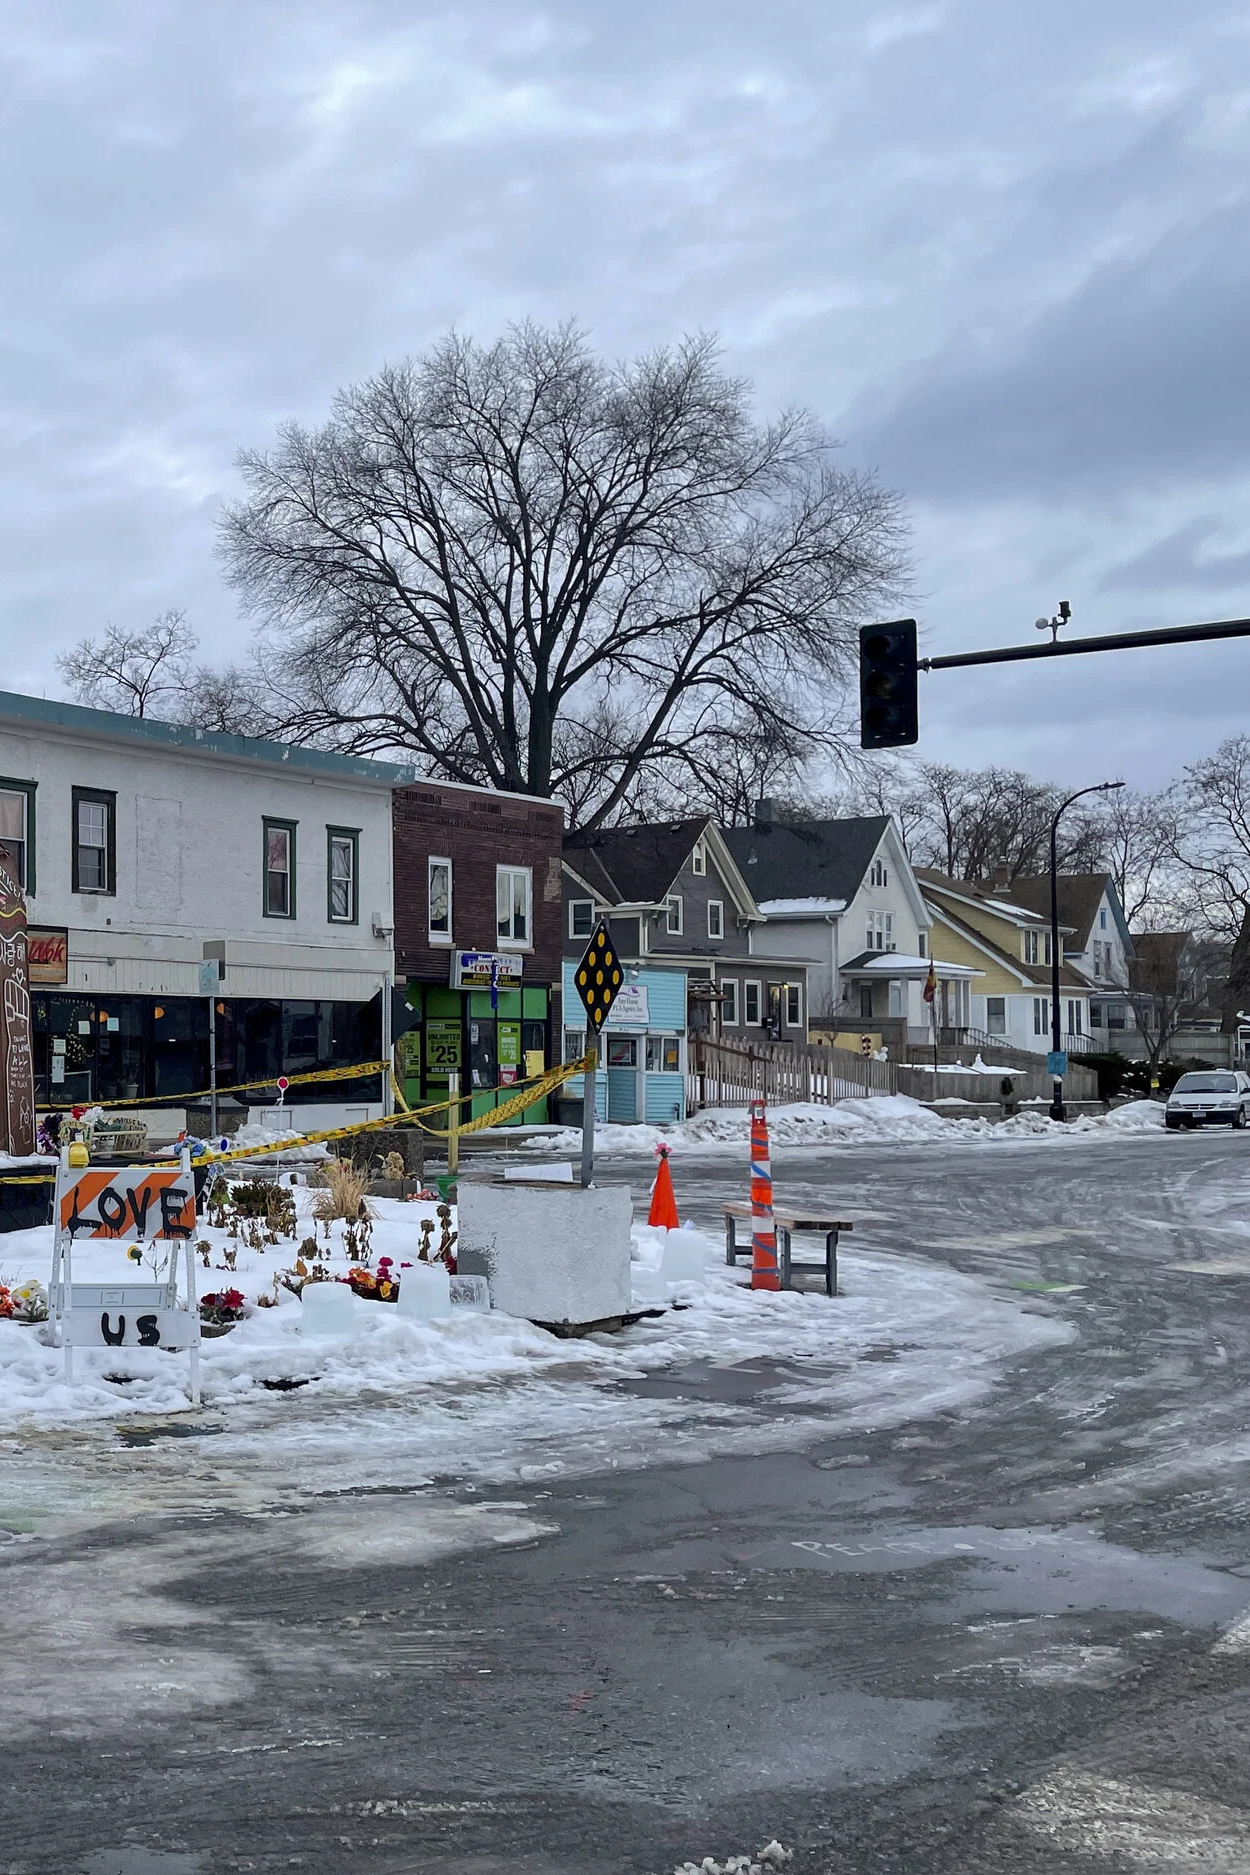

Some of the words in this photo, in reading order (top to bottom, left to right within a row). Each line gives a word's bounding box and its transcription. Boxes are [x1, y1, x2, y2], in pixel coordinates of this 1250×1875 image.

[29, 936, 65, 963] Wok
[473, 964, 511, 975] CONCT
[430, 1045, 458, 1064] $25
[68, 1186, 193, 1240] LOVE
[101, 1312, 161, 1347] US
